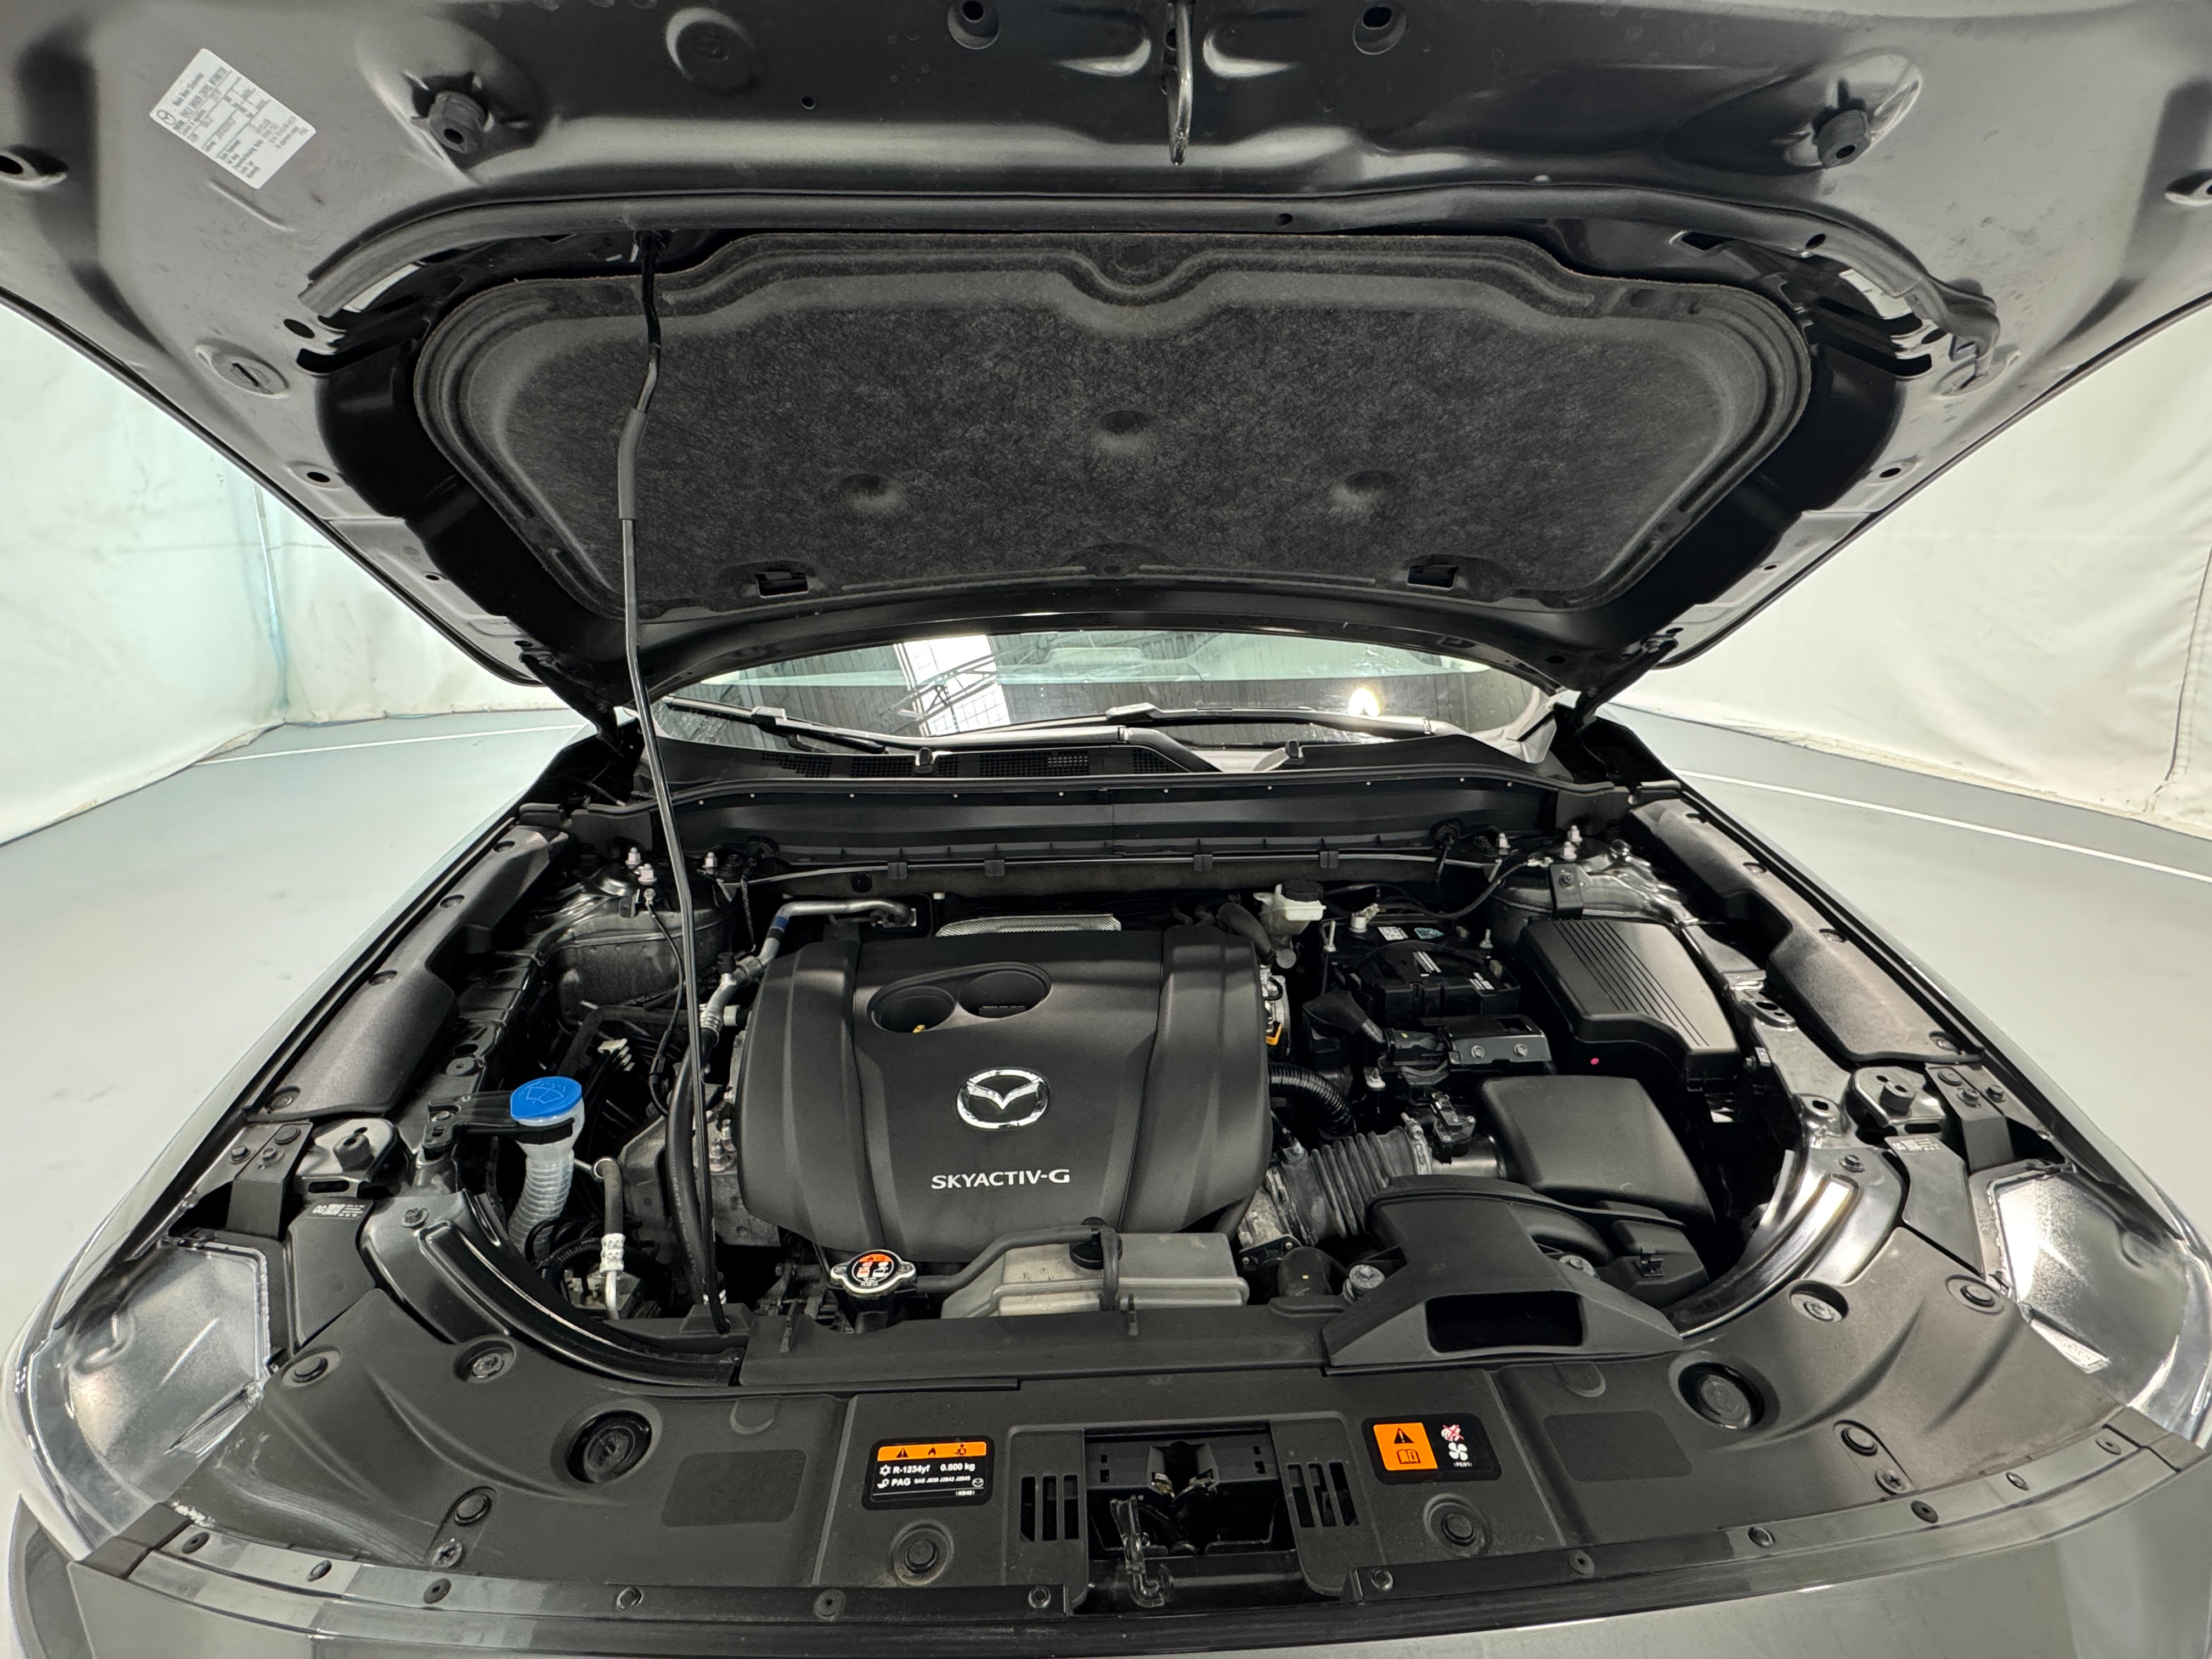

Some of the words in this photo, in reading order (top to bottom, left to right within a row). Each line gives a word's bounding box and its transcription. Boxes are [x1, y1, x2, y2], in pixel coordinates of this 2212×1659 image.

[931, 1169, 1070, 1189] SKYACTIV-G
[893, 1464, 930, 1475] R-1234yf
[940, 1463, 963, 1471] 0.500
[964, 1463, 975, 1471] kg
[891, 1478, 911, 1487] PAG
